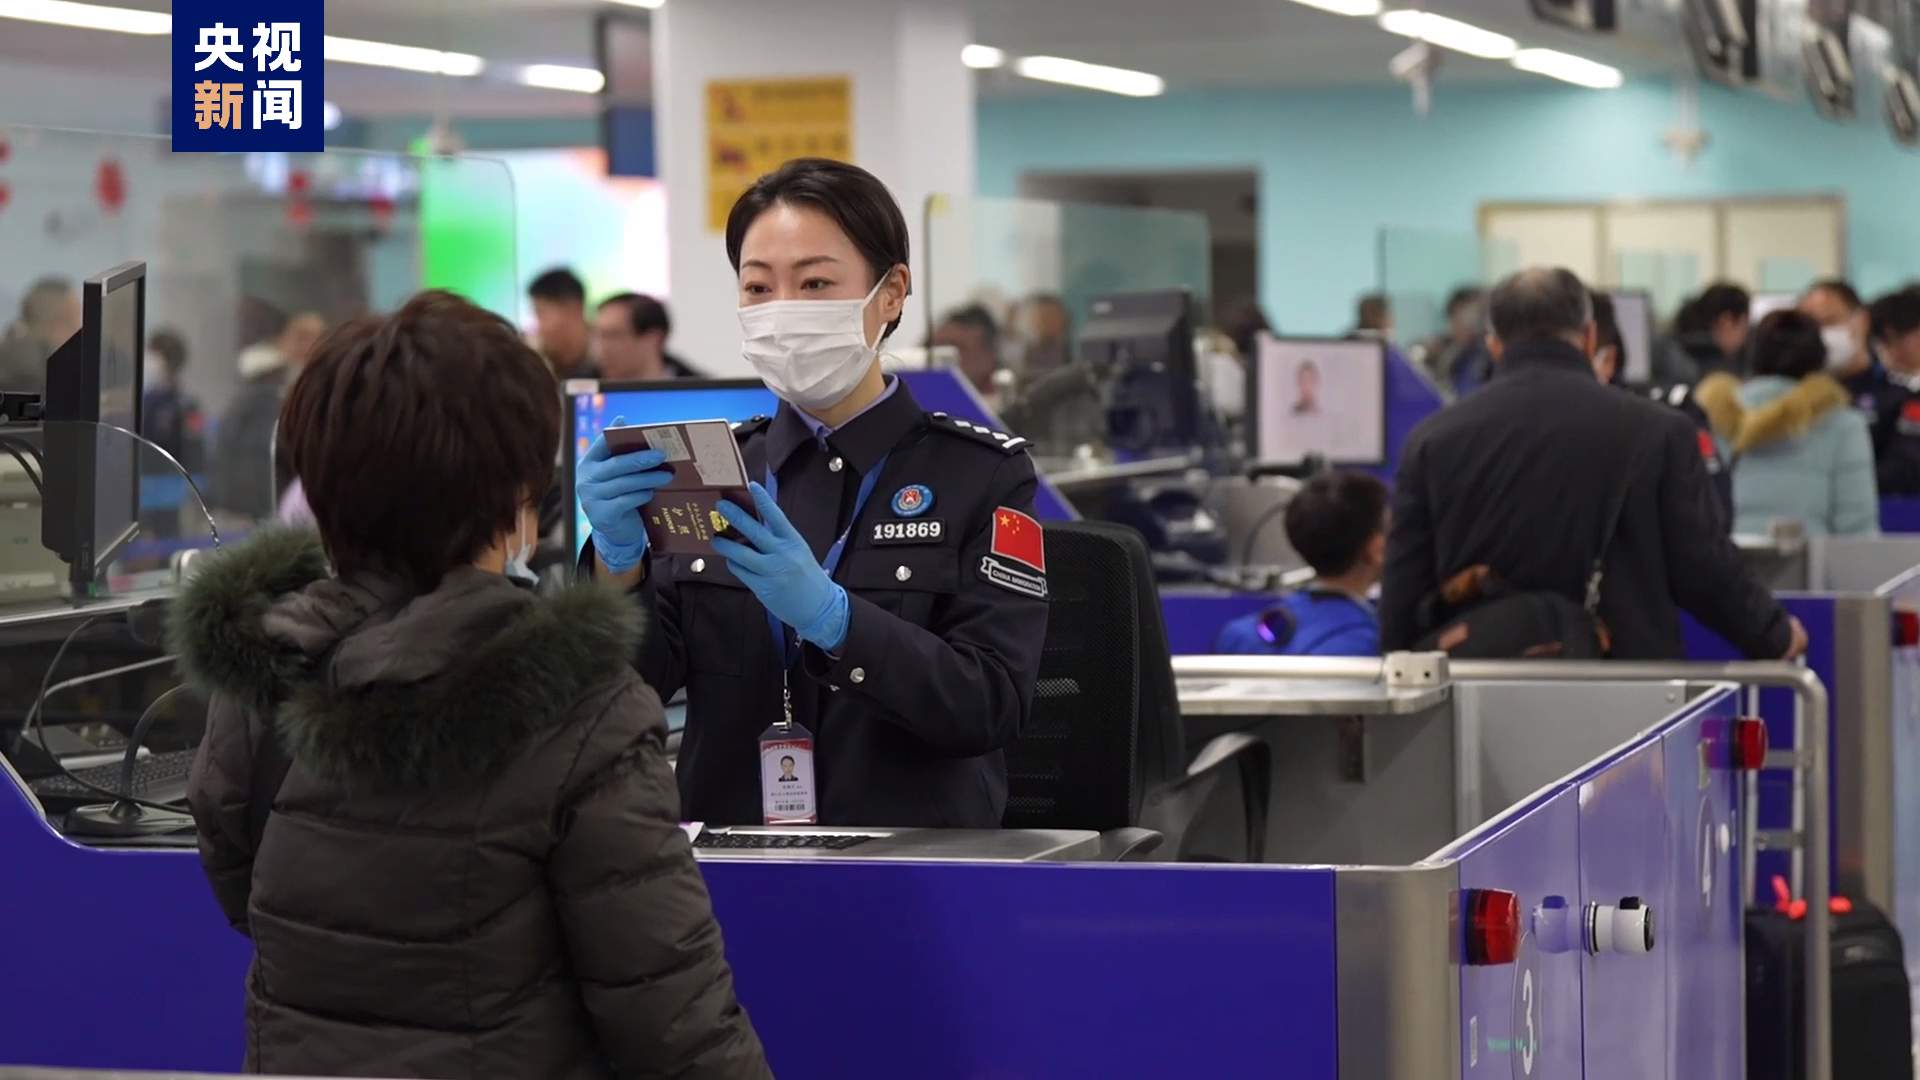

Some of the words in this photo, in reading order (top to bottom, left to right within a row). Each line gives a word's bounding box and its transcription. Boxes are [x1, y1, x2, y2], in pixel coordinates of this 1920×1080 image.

[873, 521, 942, 540] 191869
[1702, 822, 1712, 908] 4
[1522, 967, 1534, 1076] 3
